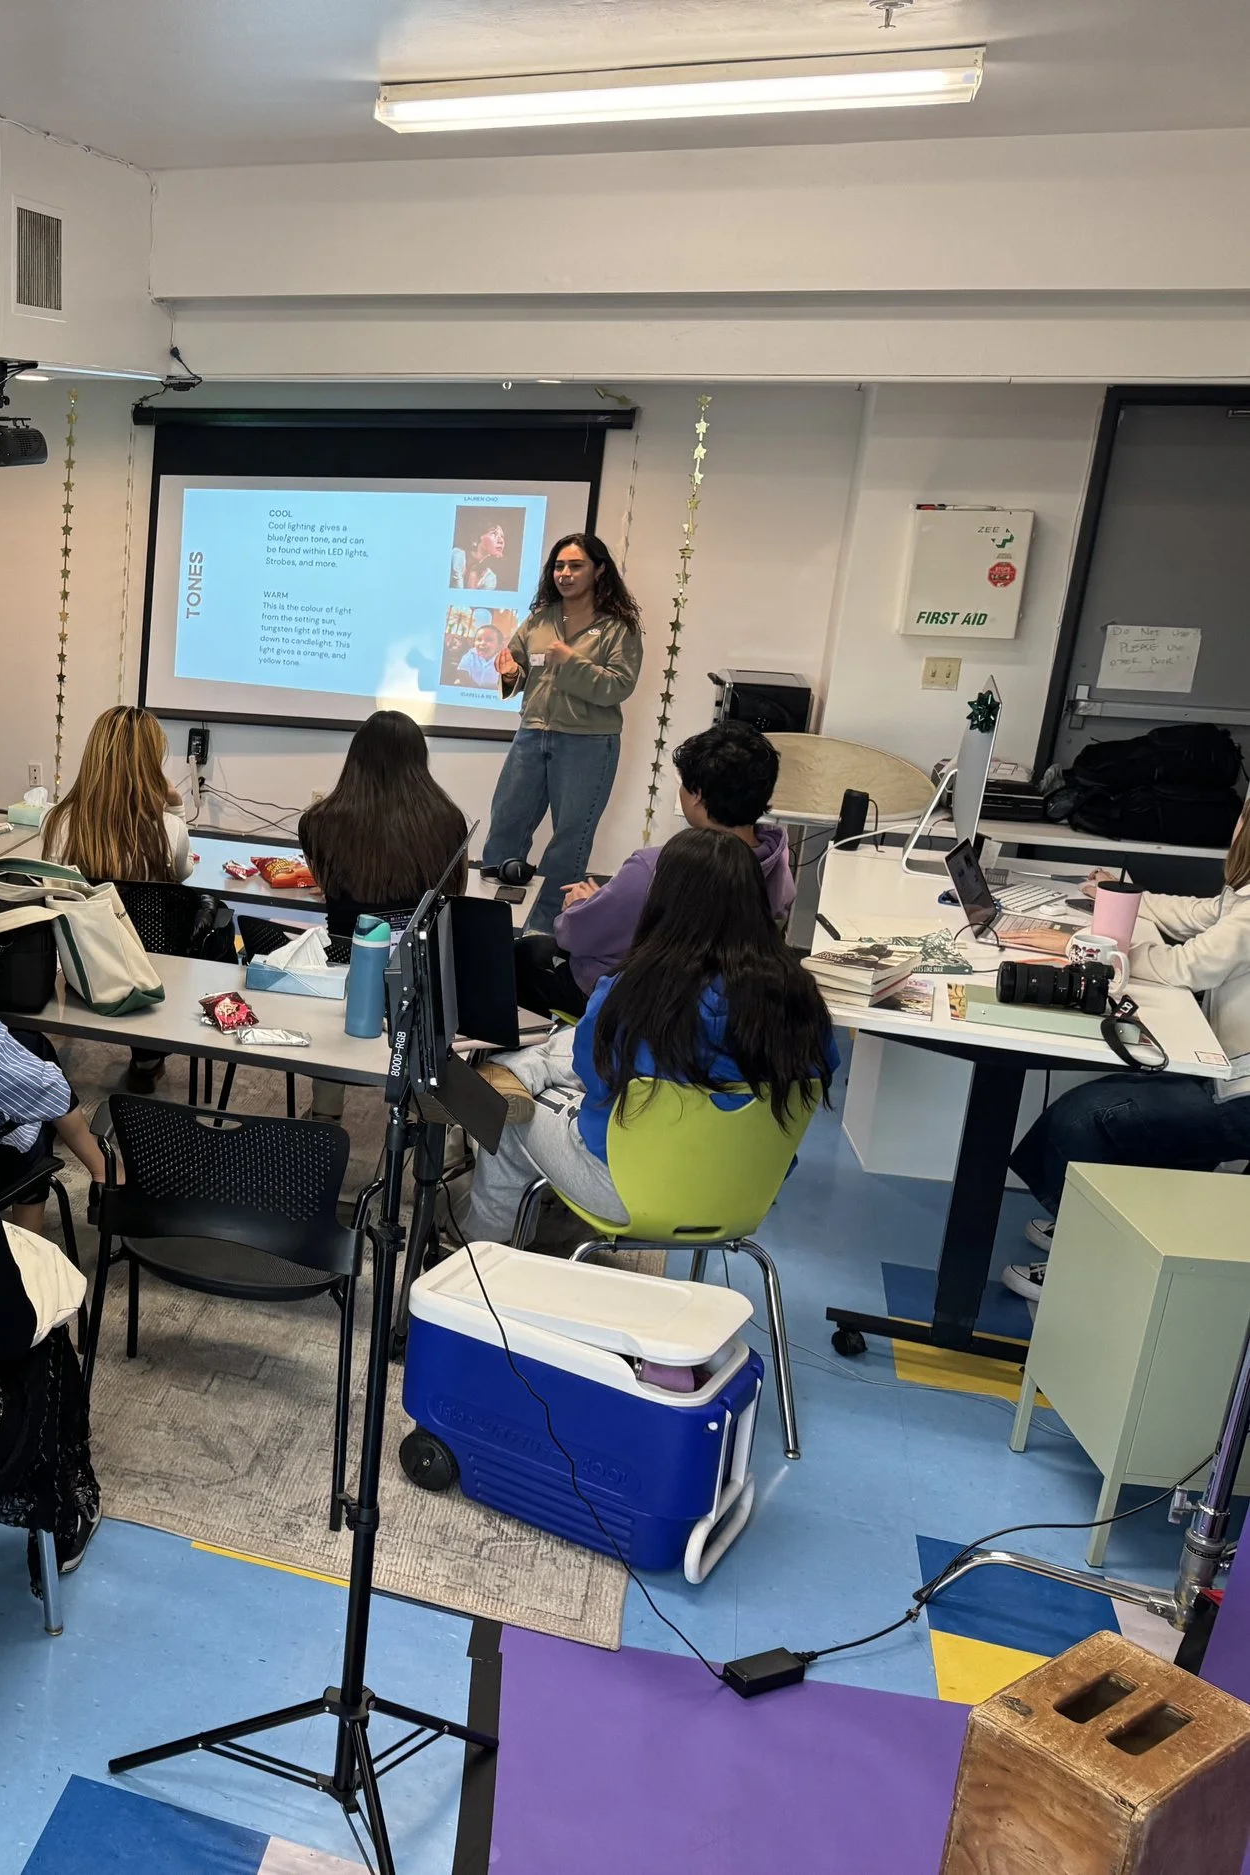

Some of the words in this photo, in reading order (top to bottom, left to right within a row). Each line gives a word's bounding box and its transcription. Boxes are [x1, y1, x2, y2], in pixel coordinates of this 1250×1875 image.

[269, 510, 292, 518] COOL
[268, 522, 286, 530] Cool
[288, 523, 316, 532] lighting
[320, 523, 340, 533] gives
[267, 534, 308, 543] blue/green
[278, 546, 301, 554] found
[303, 547, 326, 555] within
[328, 548, 343, 556] LED
[345, 549, 368, 558] lights,
[266, 557, 297, 566] Strobes,
[186, 551, 204, 619] TONES
[264, 591, 289, 599] WARM
[263, 602, 277, 610] This
[335, 607, 352, 615] light
[281, 614, 292, 622] the
[294, 616, 319, 625] setting
[916, 611, 960, 625] FIRST
[961, 612, 988, 626] AID
[261, 625, 292, 633] tungsten
[294, 627, 310, 635] light
[322, 629, 334, 637] the
[260, 635, 280, 643] down
[259, 646, 275, 654] light
[303, 650, 330, 659] orange,
[332, 652, 346, 660] and
[258, 657, 281, 665] yellow
[390, 1031, 407, 1077] 800D-RGB
